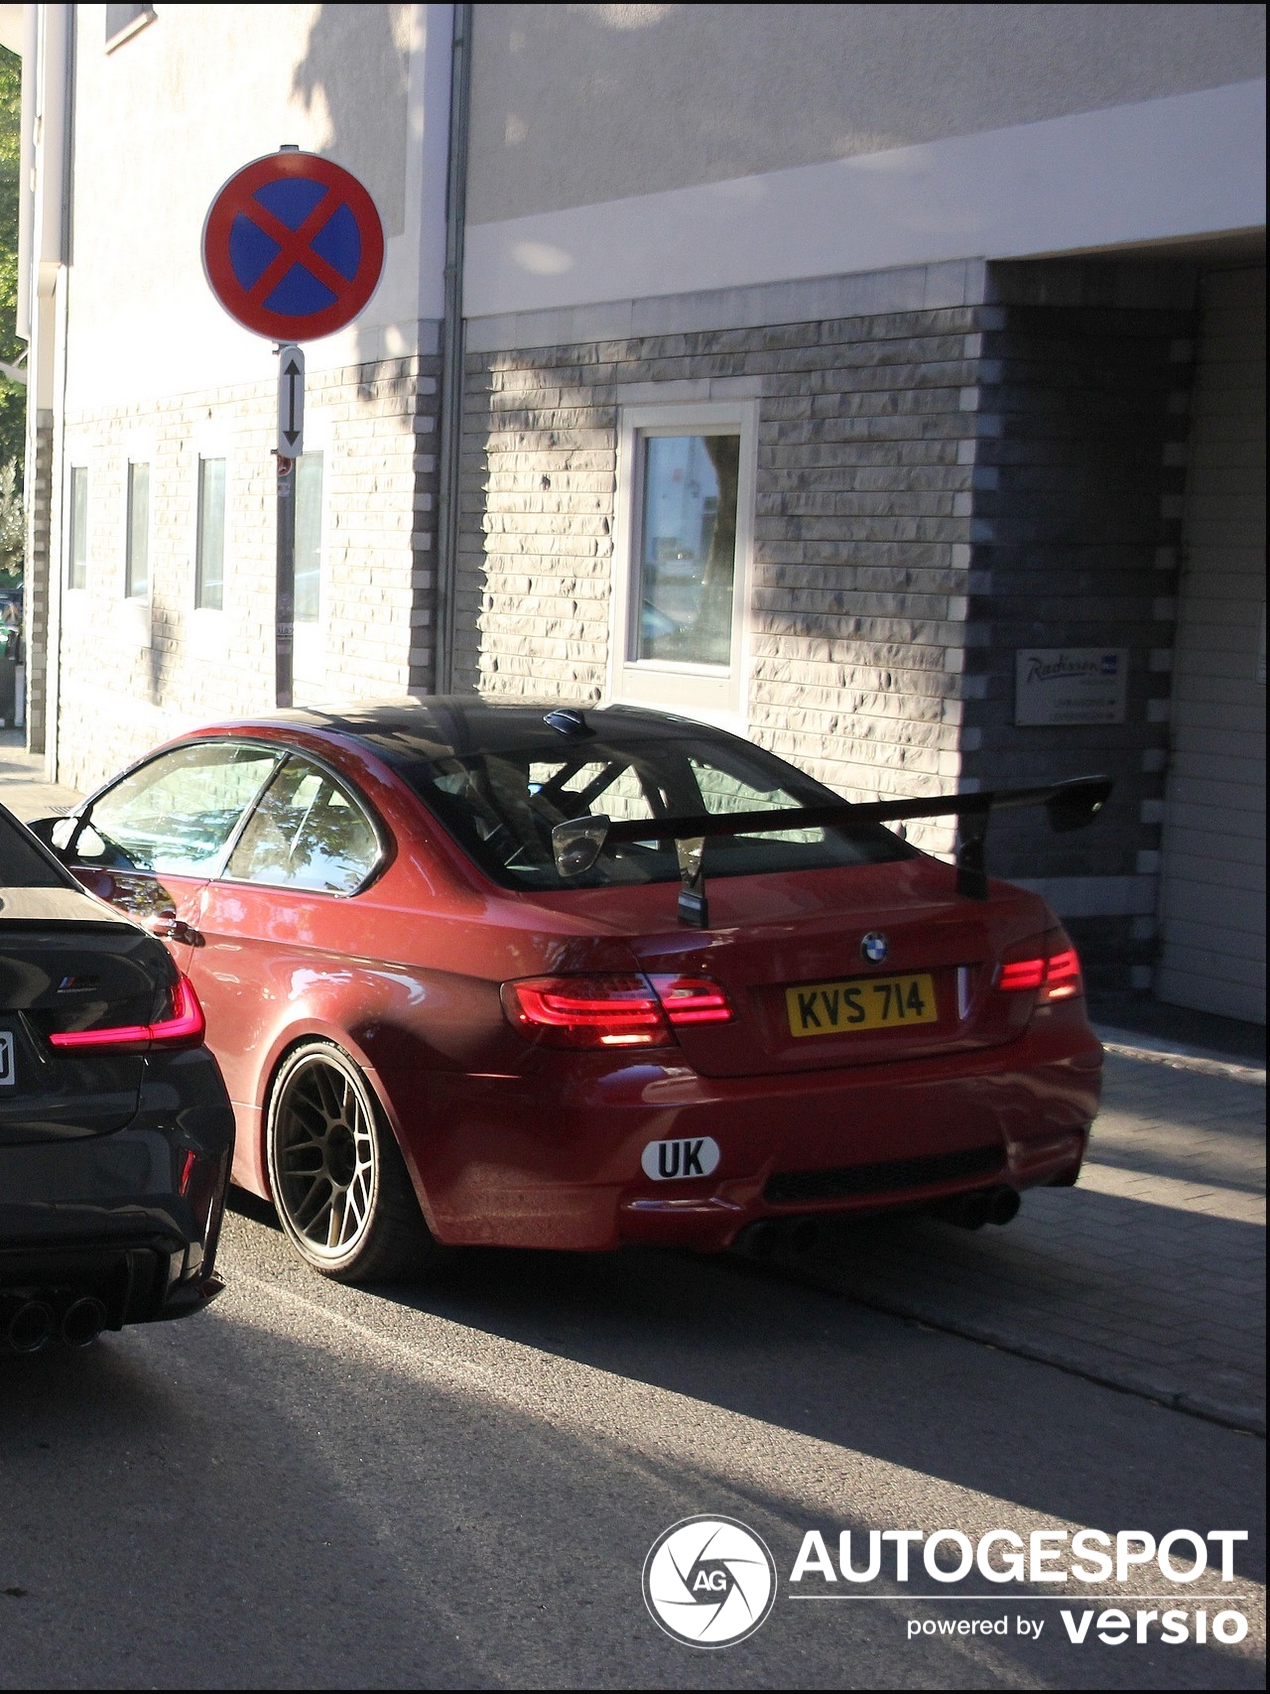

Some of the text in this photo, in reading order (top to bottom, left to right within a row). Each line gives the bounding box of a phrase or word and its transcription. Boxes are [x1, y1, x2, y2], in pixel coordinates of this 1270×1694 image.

[797, 981, 925, 1028] KVS 714
[658, 1140, 704, 1178] UK
